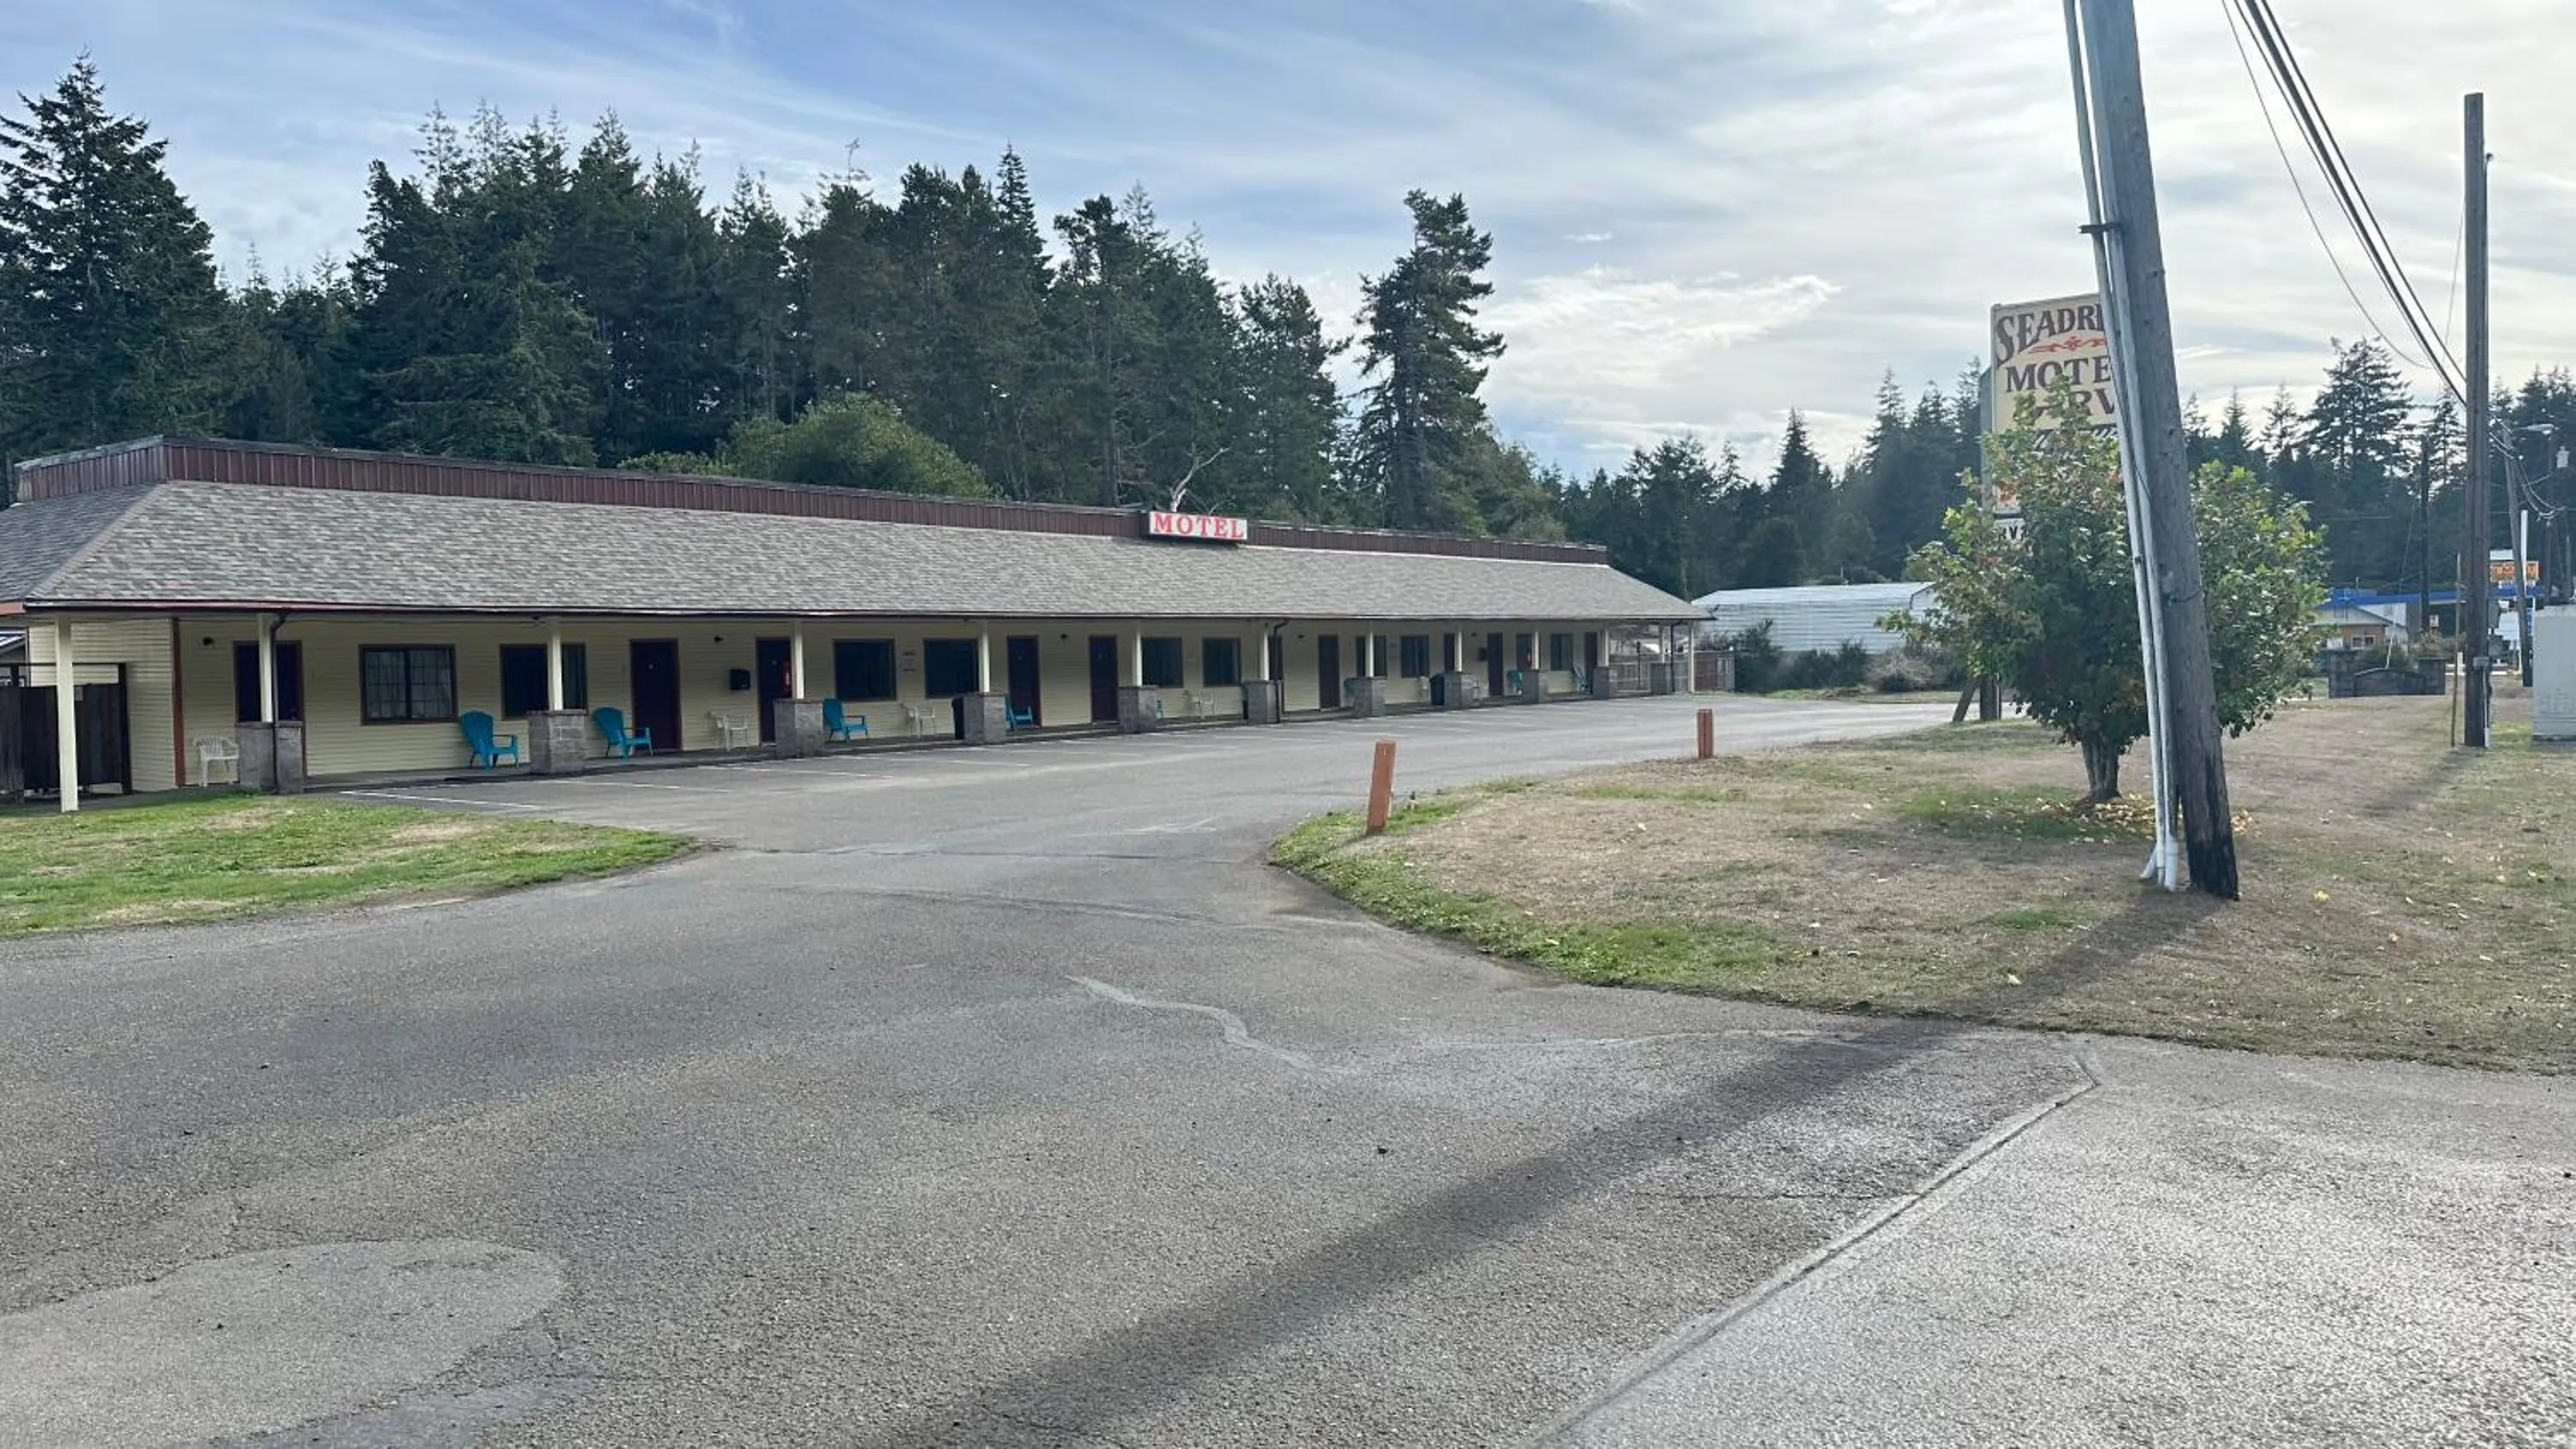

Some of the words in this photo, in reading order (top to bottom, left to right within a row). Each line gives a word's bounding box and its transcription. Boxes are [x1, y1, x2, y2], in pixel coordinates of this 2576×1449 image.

[1996, 303, 2105, 369] SEADRI
[2005, 355, 2111, 393] MOTE
[1153, 512, 1244, 538] MOTEL
